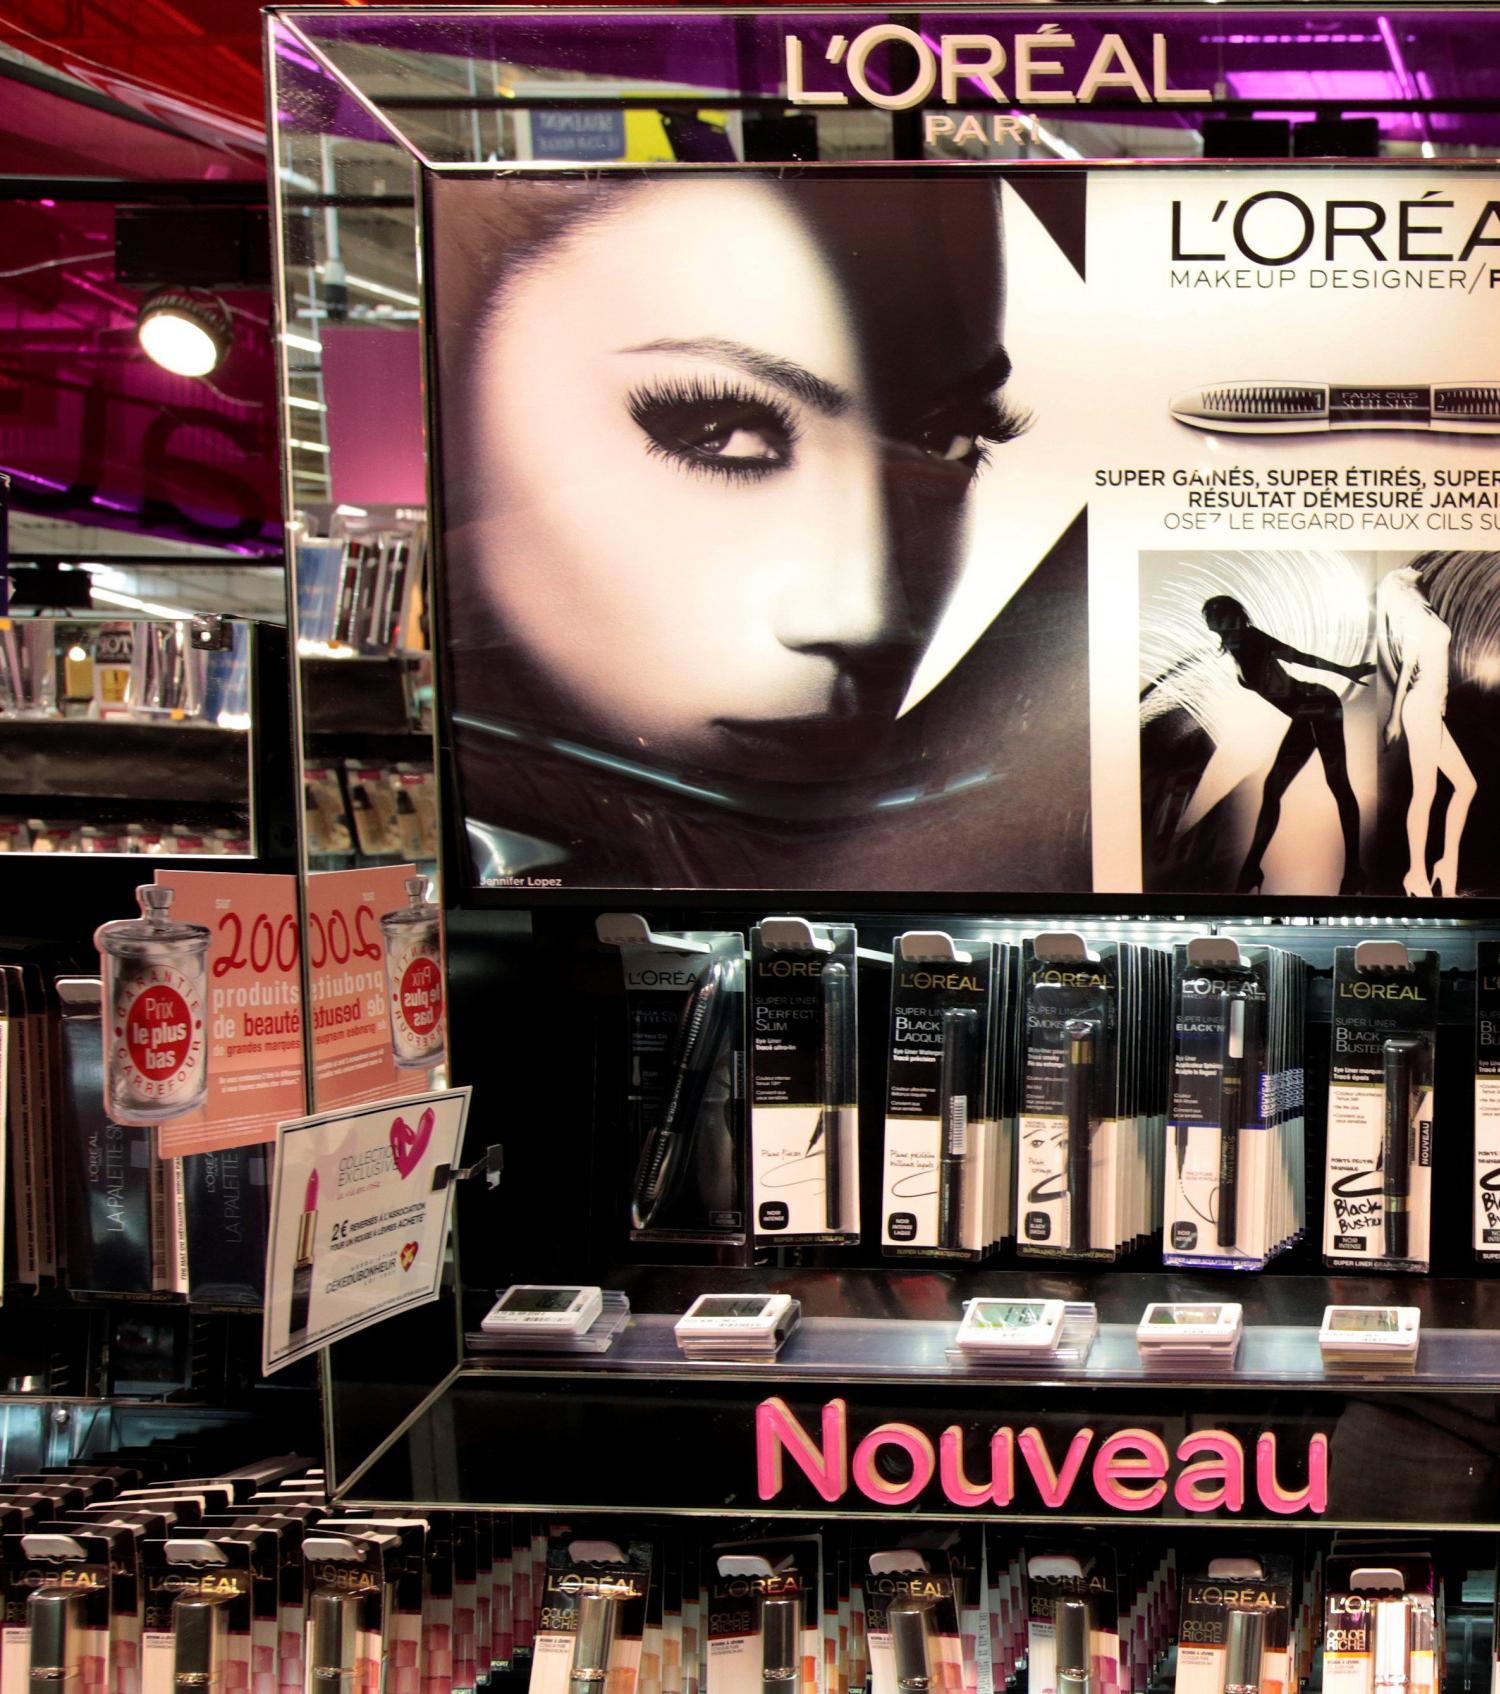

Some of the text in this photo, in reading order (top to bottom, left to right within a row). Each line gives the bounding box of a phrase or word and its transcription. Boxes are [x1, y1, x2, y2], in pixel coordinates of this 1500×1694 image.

[786, 24, 1212, 111] L'ORÉAL
[925, 113, 1041, 146] PARi
[1171, 269, 1296, 290] MAKEUP
[1095, 471, 1166, 488] SUPER
[1267, 471, 1340, 488] SUPER
[1346, 466, 1426, 490] ÉTIRÉS,
[1188, 488, 1294, 509] RÉSULTAT
[1304, 488, 1423, 509] DÉMESURÉ
[1231, 514, 1256, 530] LE
[1261, 513, 1353, 530] REGARD
[1362, 513, 1418, 530] FAUX
[1426, 513, 1473, 530] CILS
[480, 877, 562, 887] Jennifer Lopez
[900, 972, 984, 991] L'ORÉAL
[1340, 981, 1427, 1000] L'ORÉAL
[212, 981, 299, 1014] produits
[145, 997, 174, 1020] Prix
[213, 1008, 300, 1039] de beauté
[756, 1020, 788, 1031] SLIM
[896, 1016, 940, 1030] BLACK
[133, 1022, 187, 1049] le plus
[1336, 1027, 1380, 1041] BLACK
[145, 1050, 176, 1070] bas
[1421, 1122, 1430, 1165] NOUVEAU
[105, 1140, 124, 1211] PALETTE
[1333, 1198, 1382, 1219] Black
[755, 1397, 1330, 1515] Nouveau
[714, 1576, 813, 1599] L'ORÉAL
[866, 1579, 951, 1599] L'ORÉAL
[1188, 1587, 1285, 1609] L'ORÉAL
[1183, 1620, 1223, 1632] COLOR
[1327, 1630, 1366, 1641] COLOR
[1182, 1631, 1222, 1643] RICHE
[1327, 1640, 1366, 1651] RICHE
